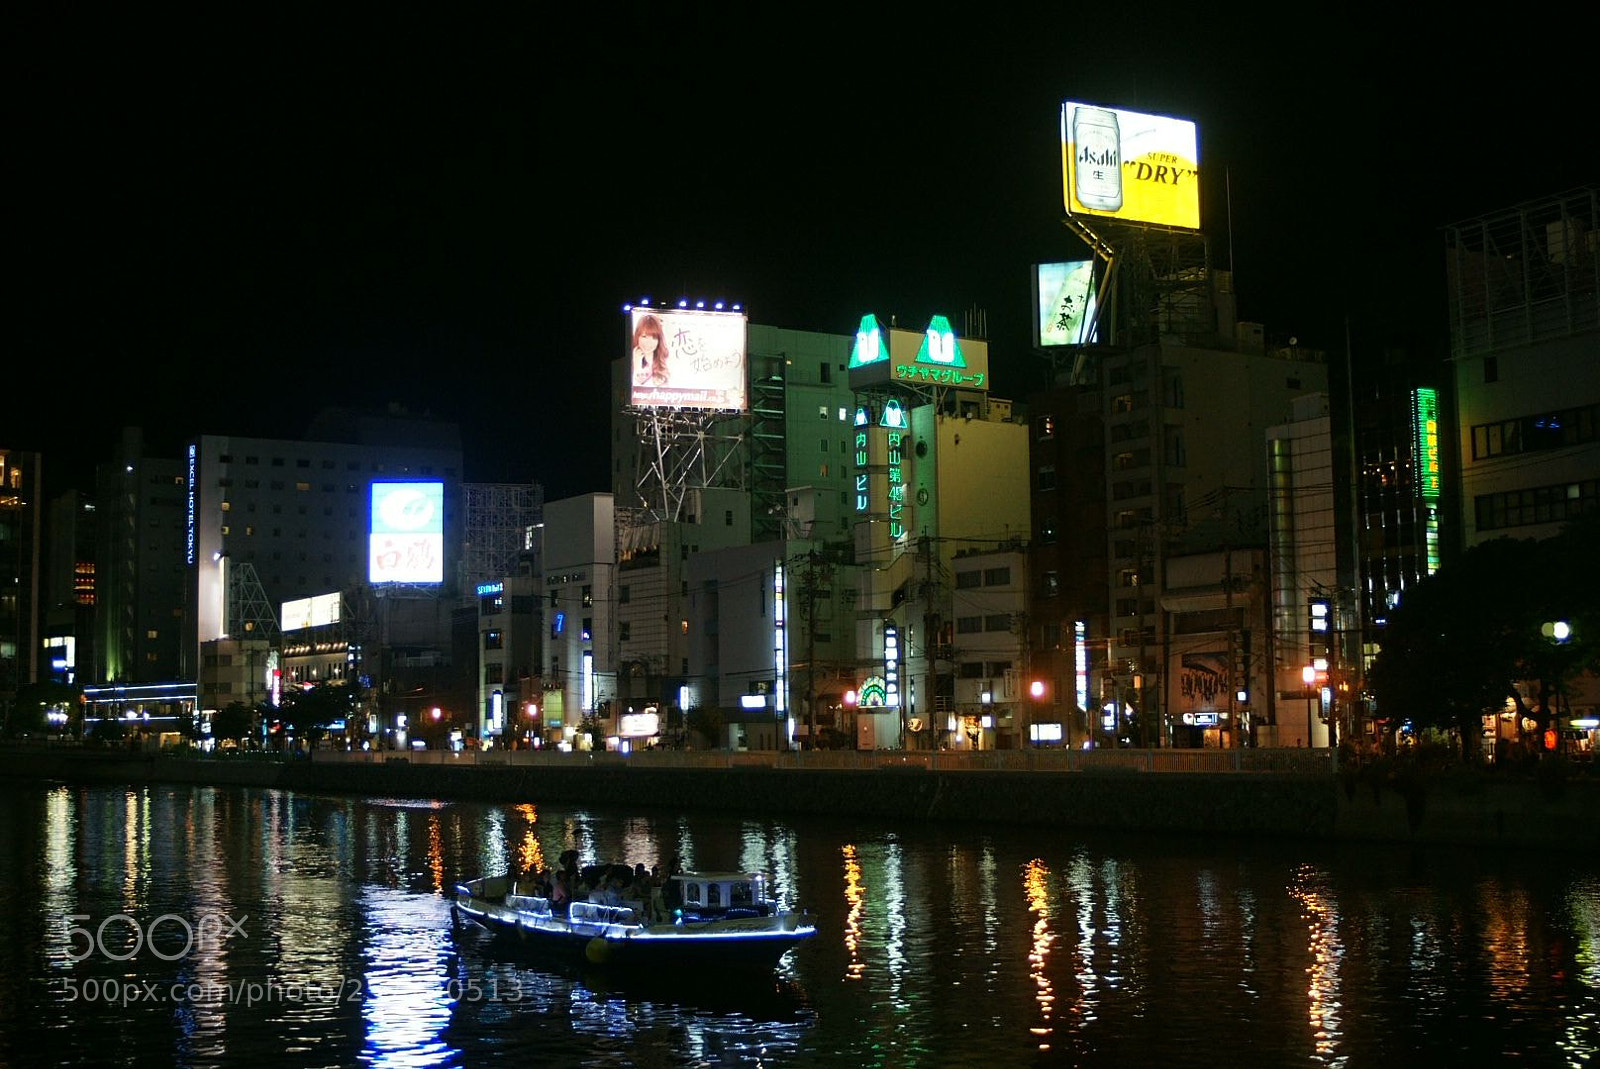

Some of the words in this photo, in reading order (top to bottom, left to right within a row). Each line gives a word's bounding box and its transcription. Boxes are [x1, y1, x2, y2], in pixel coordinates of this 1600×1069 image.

[1079, 146, 1117, 167] Asahi
[1147, 152, 1178, 164] SUPER
[1092, 170, 1104, 180] 生
[896, 364, 984, 386] ウチヤマグループ
[856, 432, 867, 510] 内山ビル
